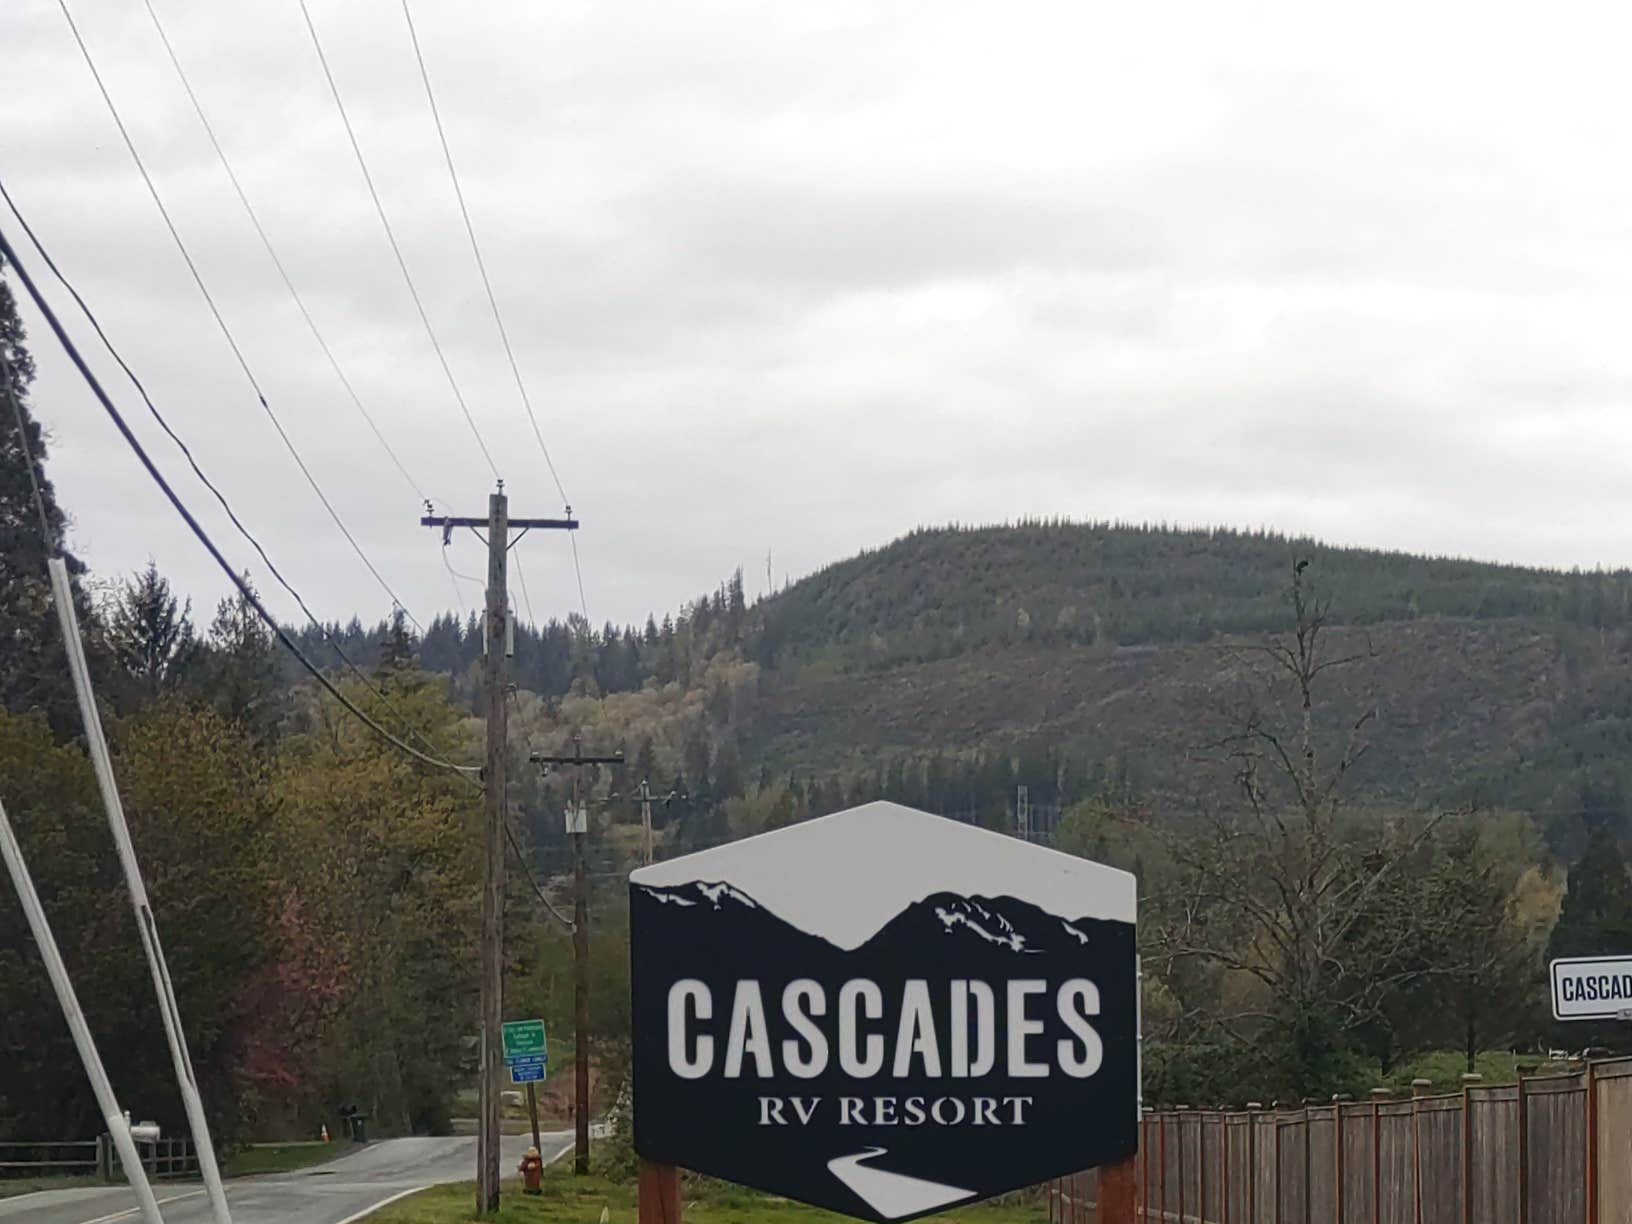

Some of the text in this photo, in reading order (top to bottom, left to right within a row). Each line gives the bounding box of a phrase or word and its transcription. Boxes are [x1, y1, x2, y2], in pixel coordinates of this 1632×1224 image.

[667, 978, 1103, 1079] CASCADES
[757, 1096, 1033, 1126] RV RESORT
